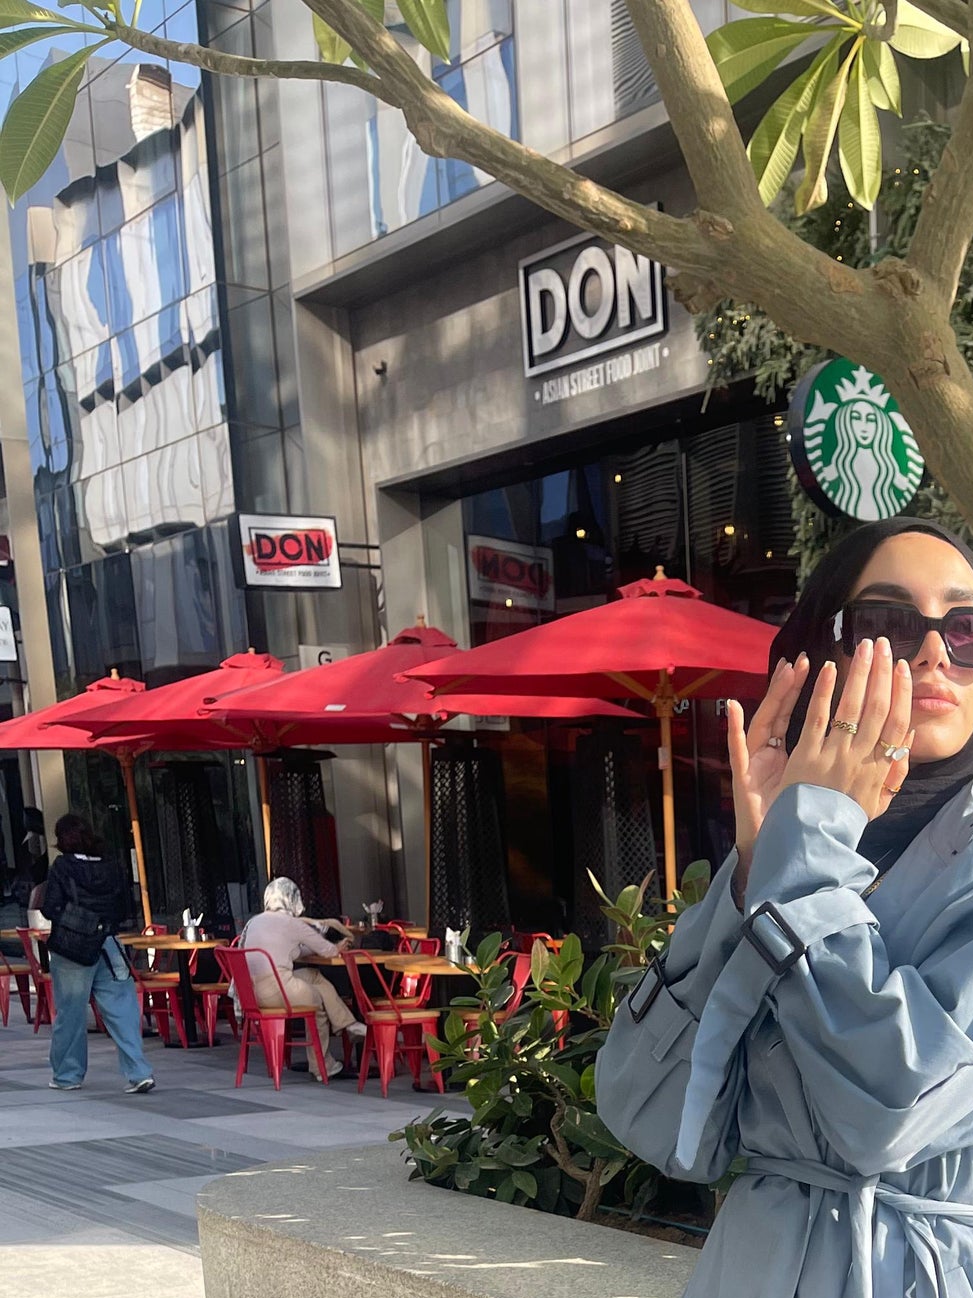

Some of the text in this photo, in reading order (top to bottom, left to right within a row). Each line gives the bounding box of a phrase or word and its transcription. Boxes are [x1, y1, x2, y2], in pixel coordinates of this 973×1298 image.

[528, 243, 653, 357] DON
[542, 374, 570, 405] ASIAN
[569, 362, 605, 396] STREET
[606, 353, 632, 385] FOOD
[254, 532, 325, 562] DON
